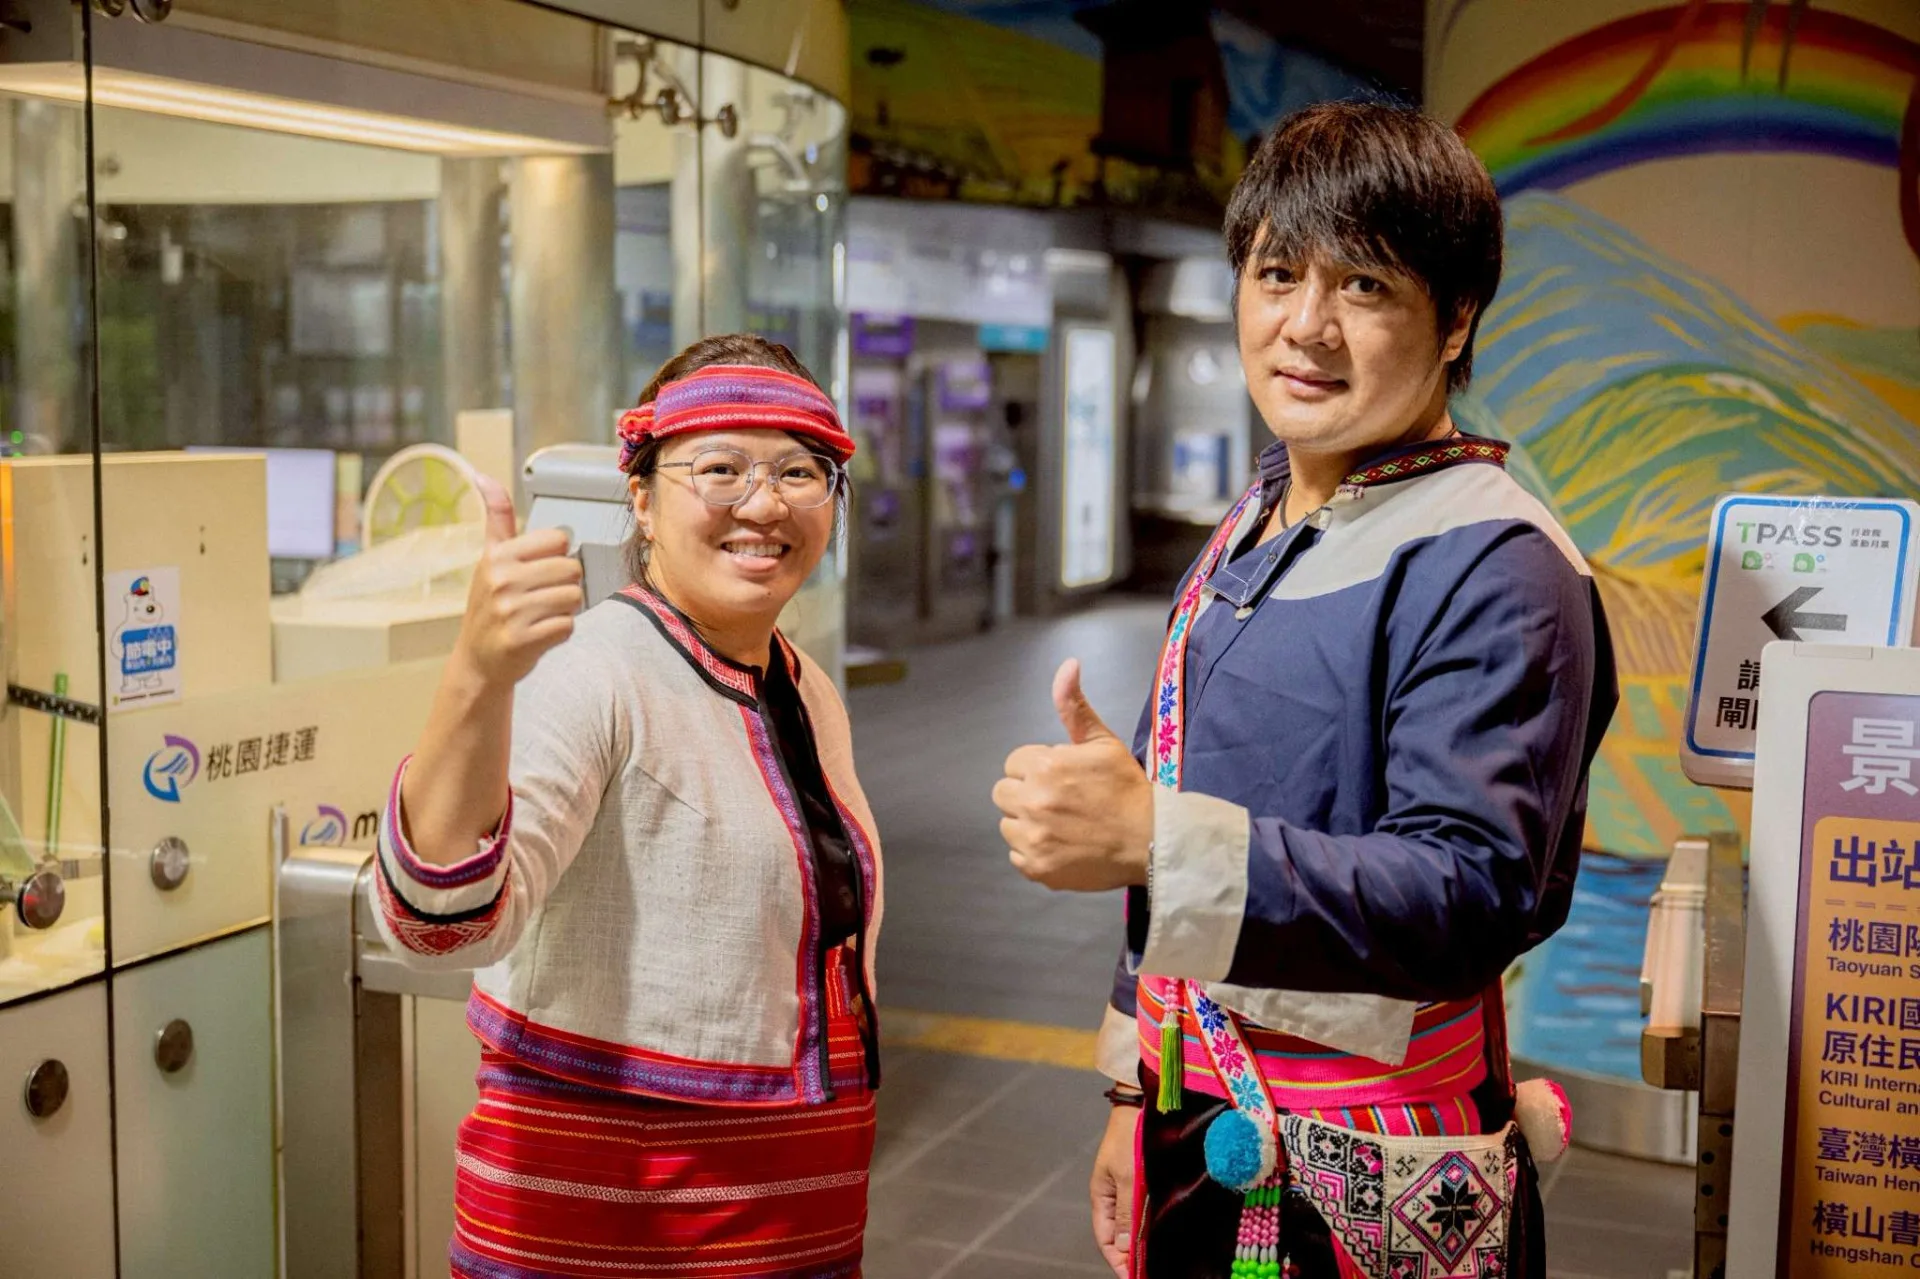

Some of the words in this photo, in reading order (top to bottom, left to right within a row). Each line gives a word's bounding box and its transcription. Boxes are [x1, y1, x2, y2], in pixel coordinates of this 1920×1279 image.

[1736, 521, 1843, 548] TPASS
[1716, 696, 1759, 730] 閘
[206, 725, 318, 782] 桃園捷運
[1840, 715, 1920, 796] 景
[1829, 836, 1920, 890] 出站
[1826, 956, 1902, 978] Taoyuan
[1820, 1069, 1858, 1088] KIRI
[1819, 1090, 1890, 1112] Cultural
[1815, 1166, 1877, 1188] Taiwan
[1884, 1174, 1920, 1193] Hen
[1812, 1200, 1920, 1247] 橫山書
[1810, 1239, 1904, 1266] Hengshan
